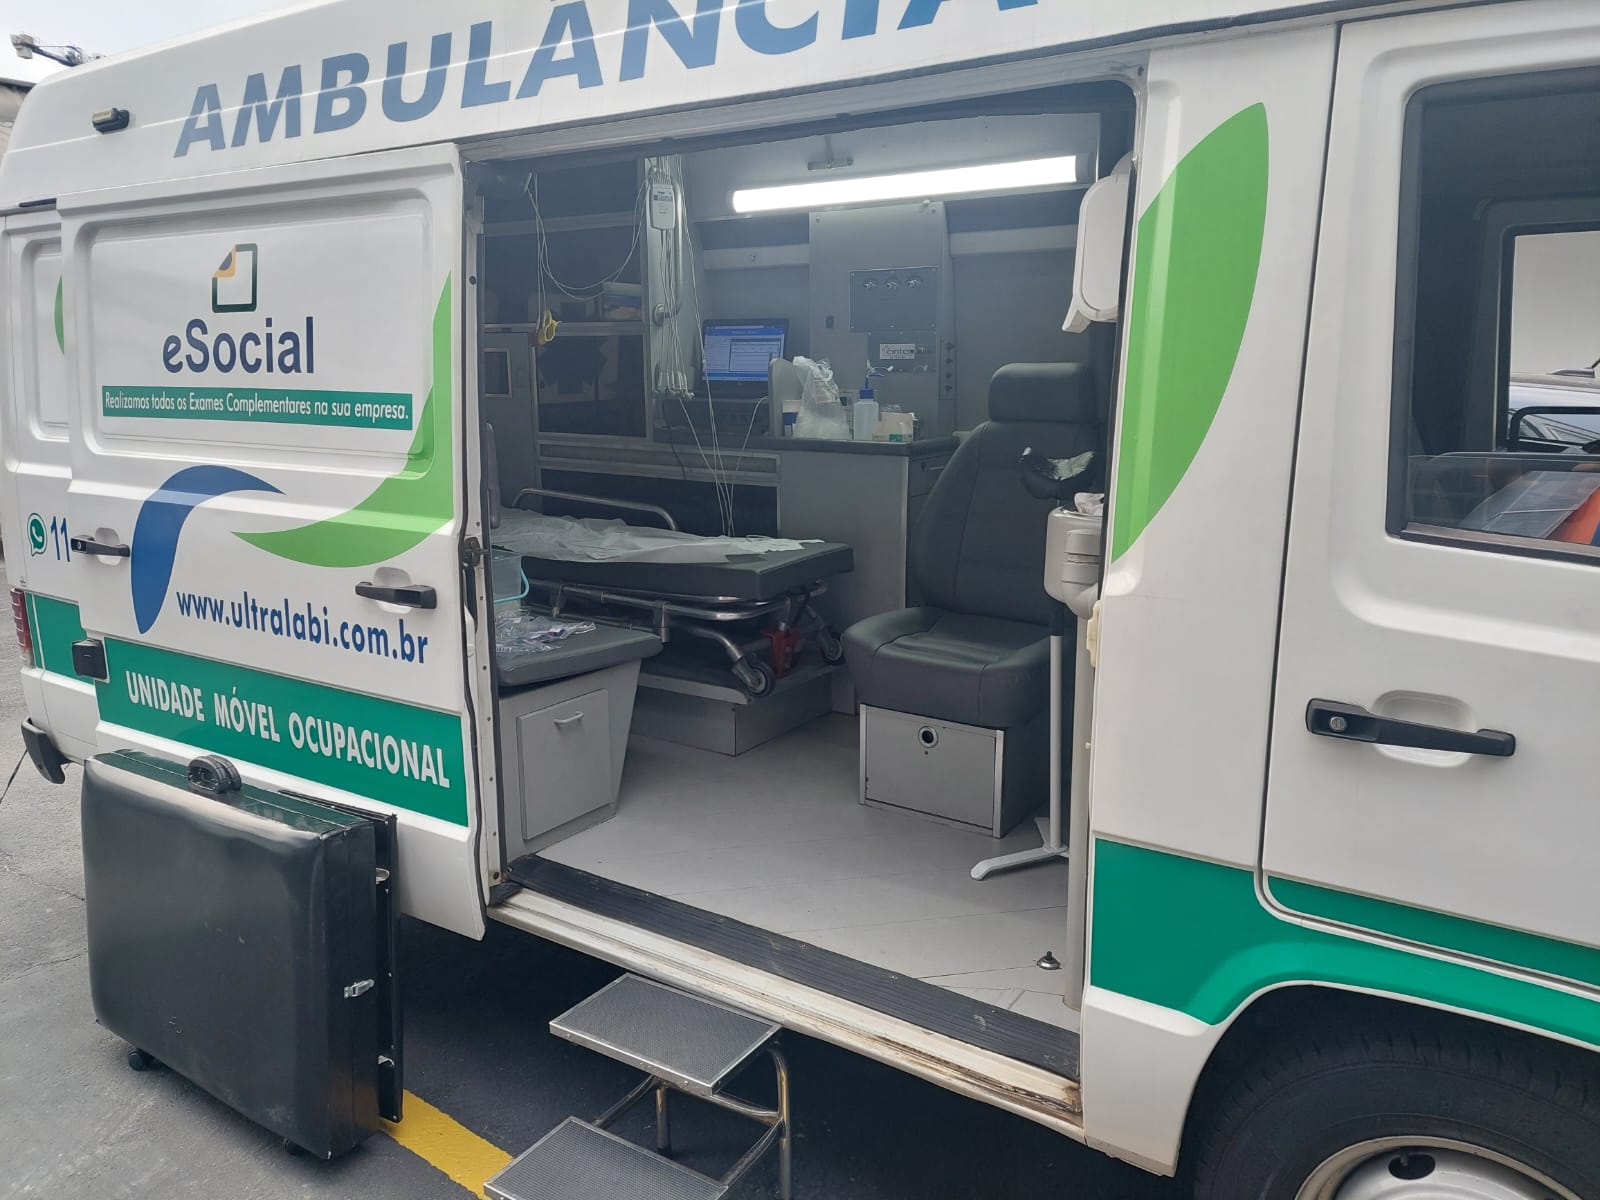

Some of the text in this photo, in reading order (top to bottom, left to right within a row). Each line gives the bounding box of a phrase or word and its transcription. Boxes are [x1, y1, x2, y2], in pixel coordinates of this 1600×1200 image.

[173, 0, 1038, 158] AMBULÂNC
[162, 316, 314, 374] eSocial
[105, 391, 409, 423] Realizamos todos os Exames Complementares na sua empresa.
[51, 516, 70, 563] 11
[176, 591, 428, 664] www.ultralabi.com.br
[125, 670, 450, 789] UNIDADE MÓVEL OCUPACIONAL
